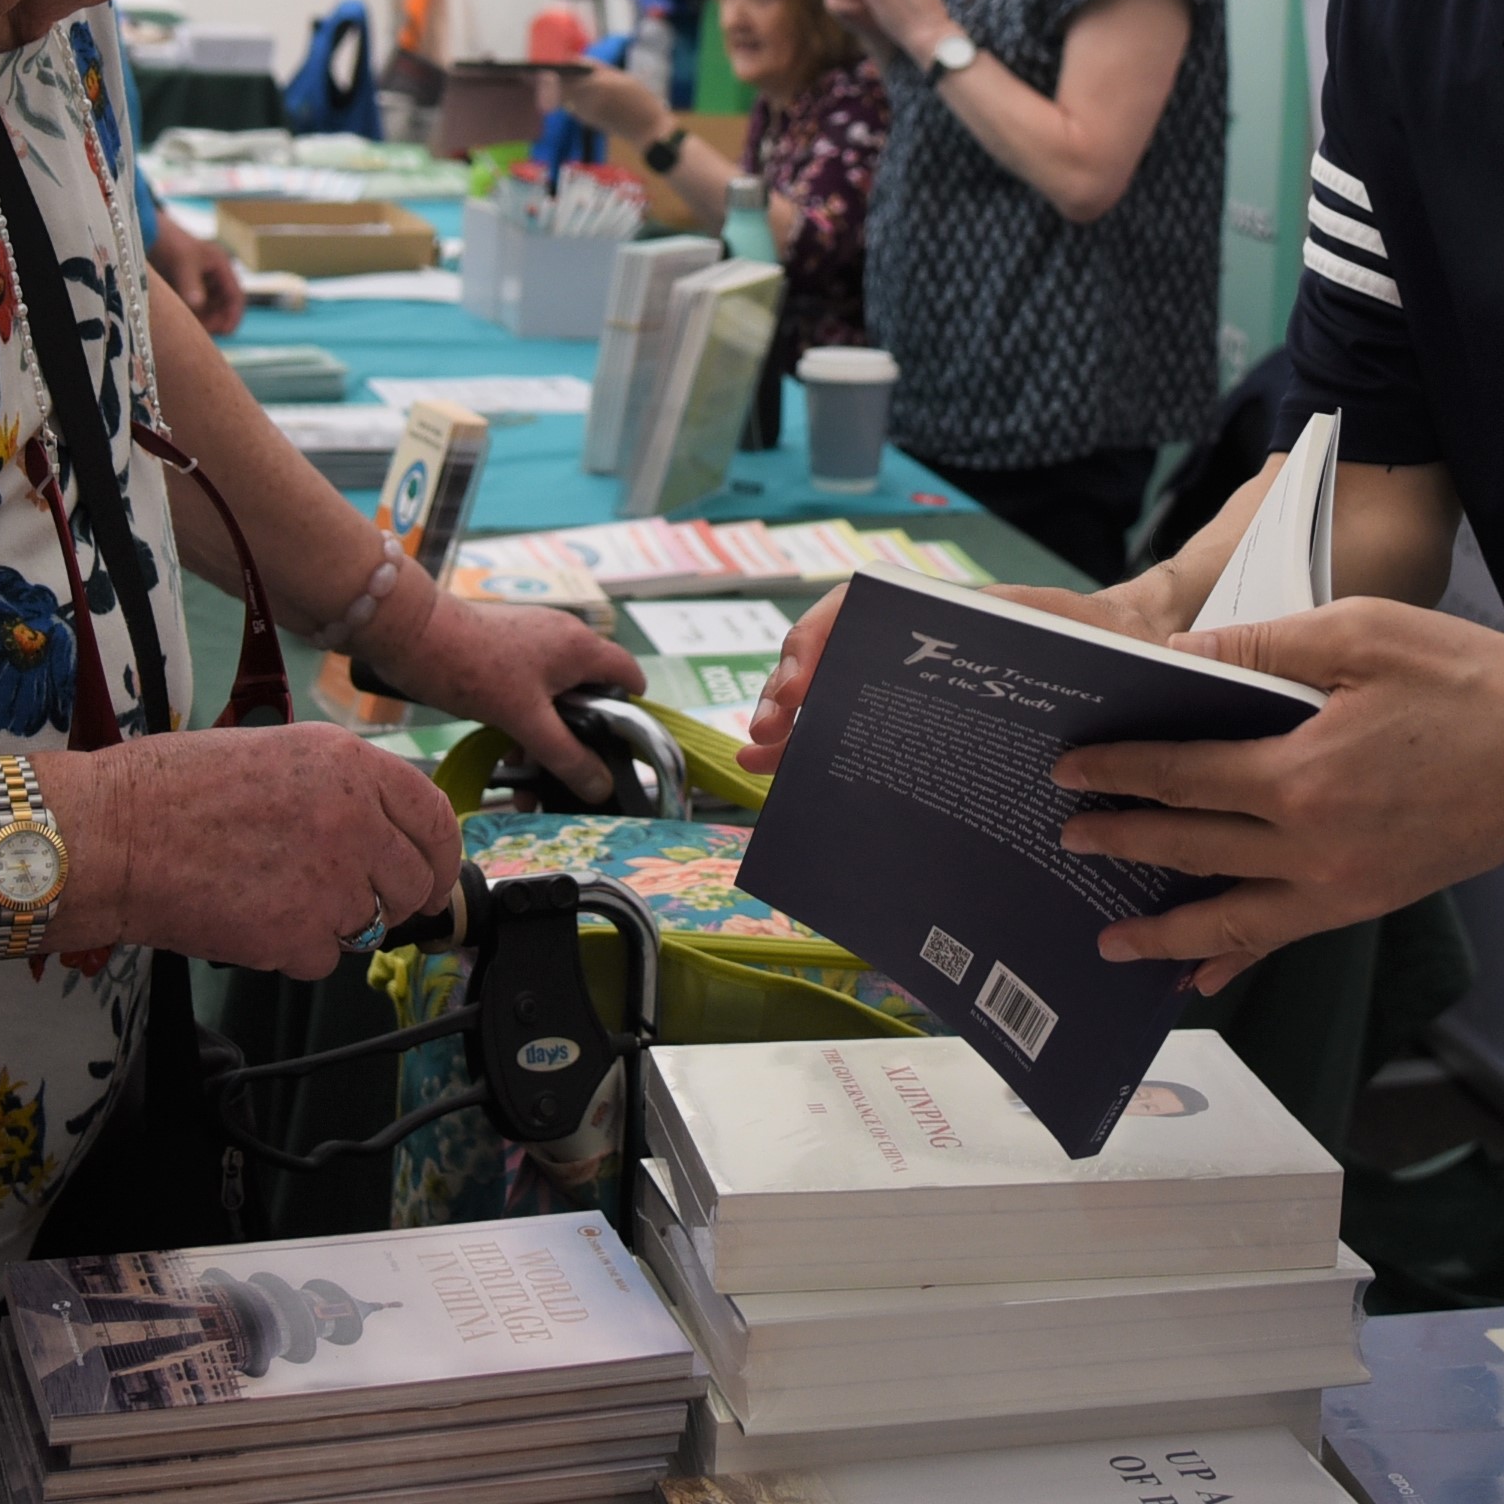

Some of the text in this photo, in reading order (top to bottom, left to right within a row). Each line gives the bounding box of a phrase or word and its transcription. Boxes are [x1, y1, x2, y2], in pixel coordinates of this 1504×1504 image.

[948, 676, 978, 691] the
[978, 680, 1057, 712] Study
[1002, 668, 1105, 703] Treasures
[526, 1045, 569, 1066] days
[807, 1103, 828, 1114] III
[821, 1048, 909, 1173] THE GOVERNANCE OF CHINA
[881, 1065, 963, 1149] XI JINPING
[417, 1250, 498, 1344] IN CHINA
[459, 1241, 553, 1344] HERITAGE
[517, 1247, 589, 1323] WORLD
[1109, 1455, 1163, 1486] OF
[1165, 1449, 1217, 1480] UP
